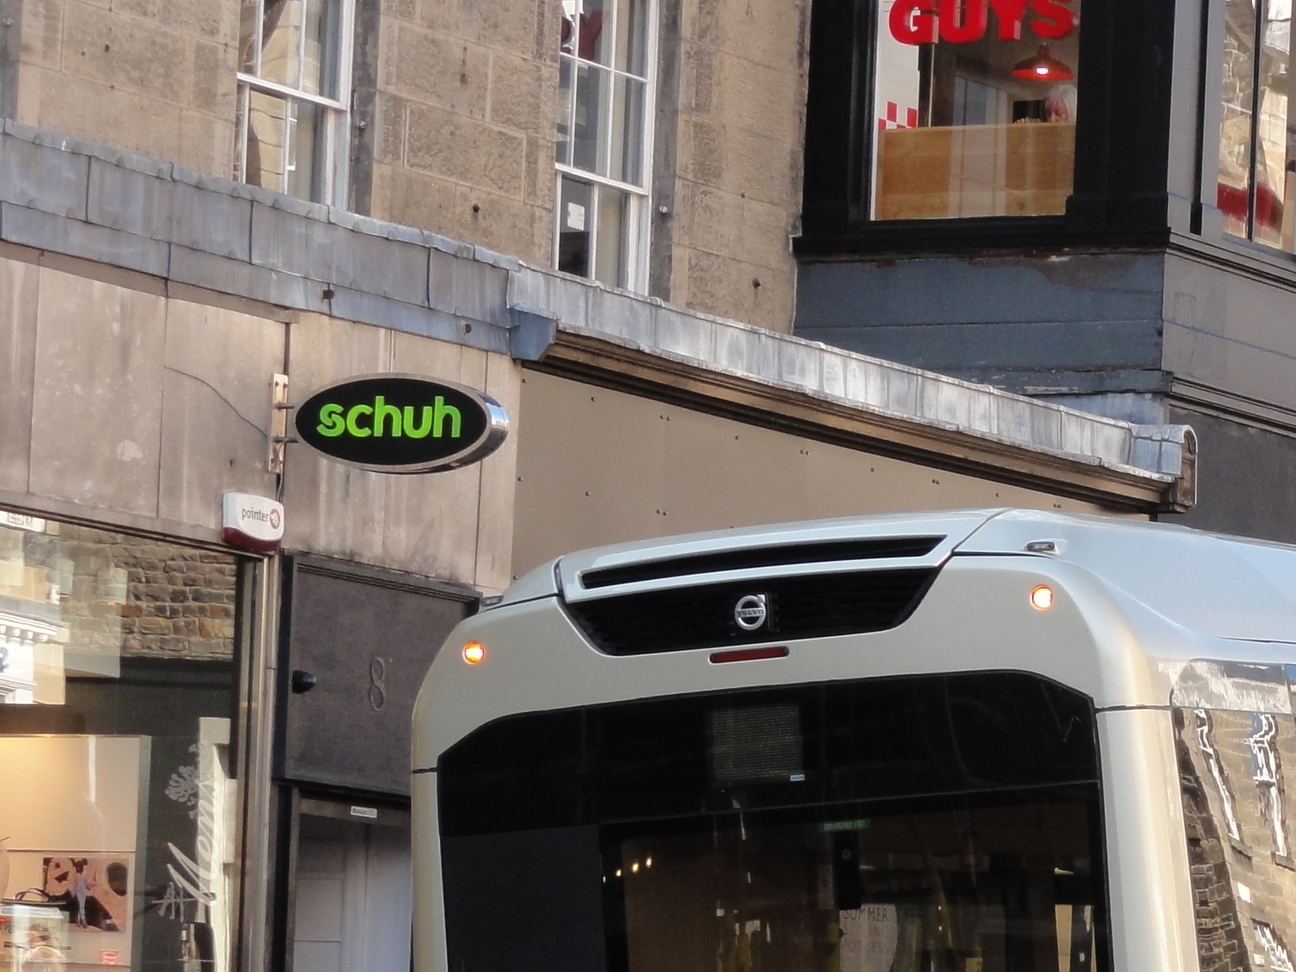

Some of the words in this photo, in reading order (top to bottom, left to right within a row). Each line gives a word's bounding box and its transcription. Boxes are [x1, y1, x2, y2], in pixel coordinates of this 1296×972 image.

[888, 0, 1078, 45] GUYS
[317, 396, 461, 438] schuh
[241, 507, 269, 524] pointer
